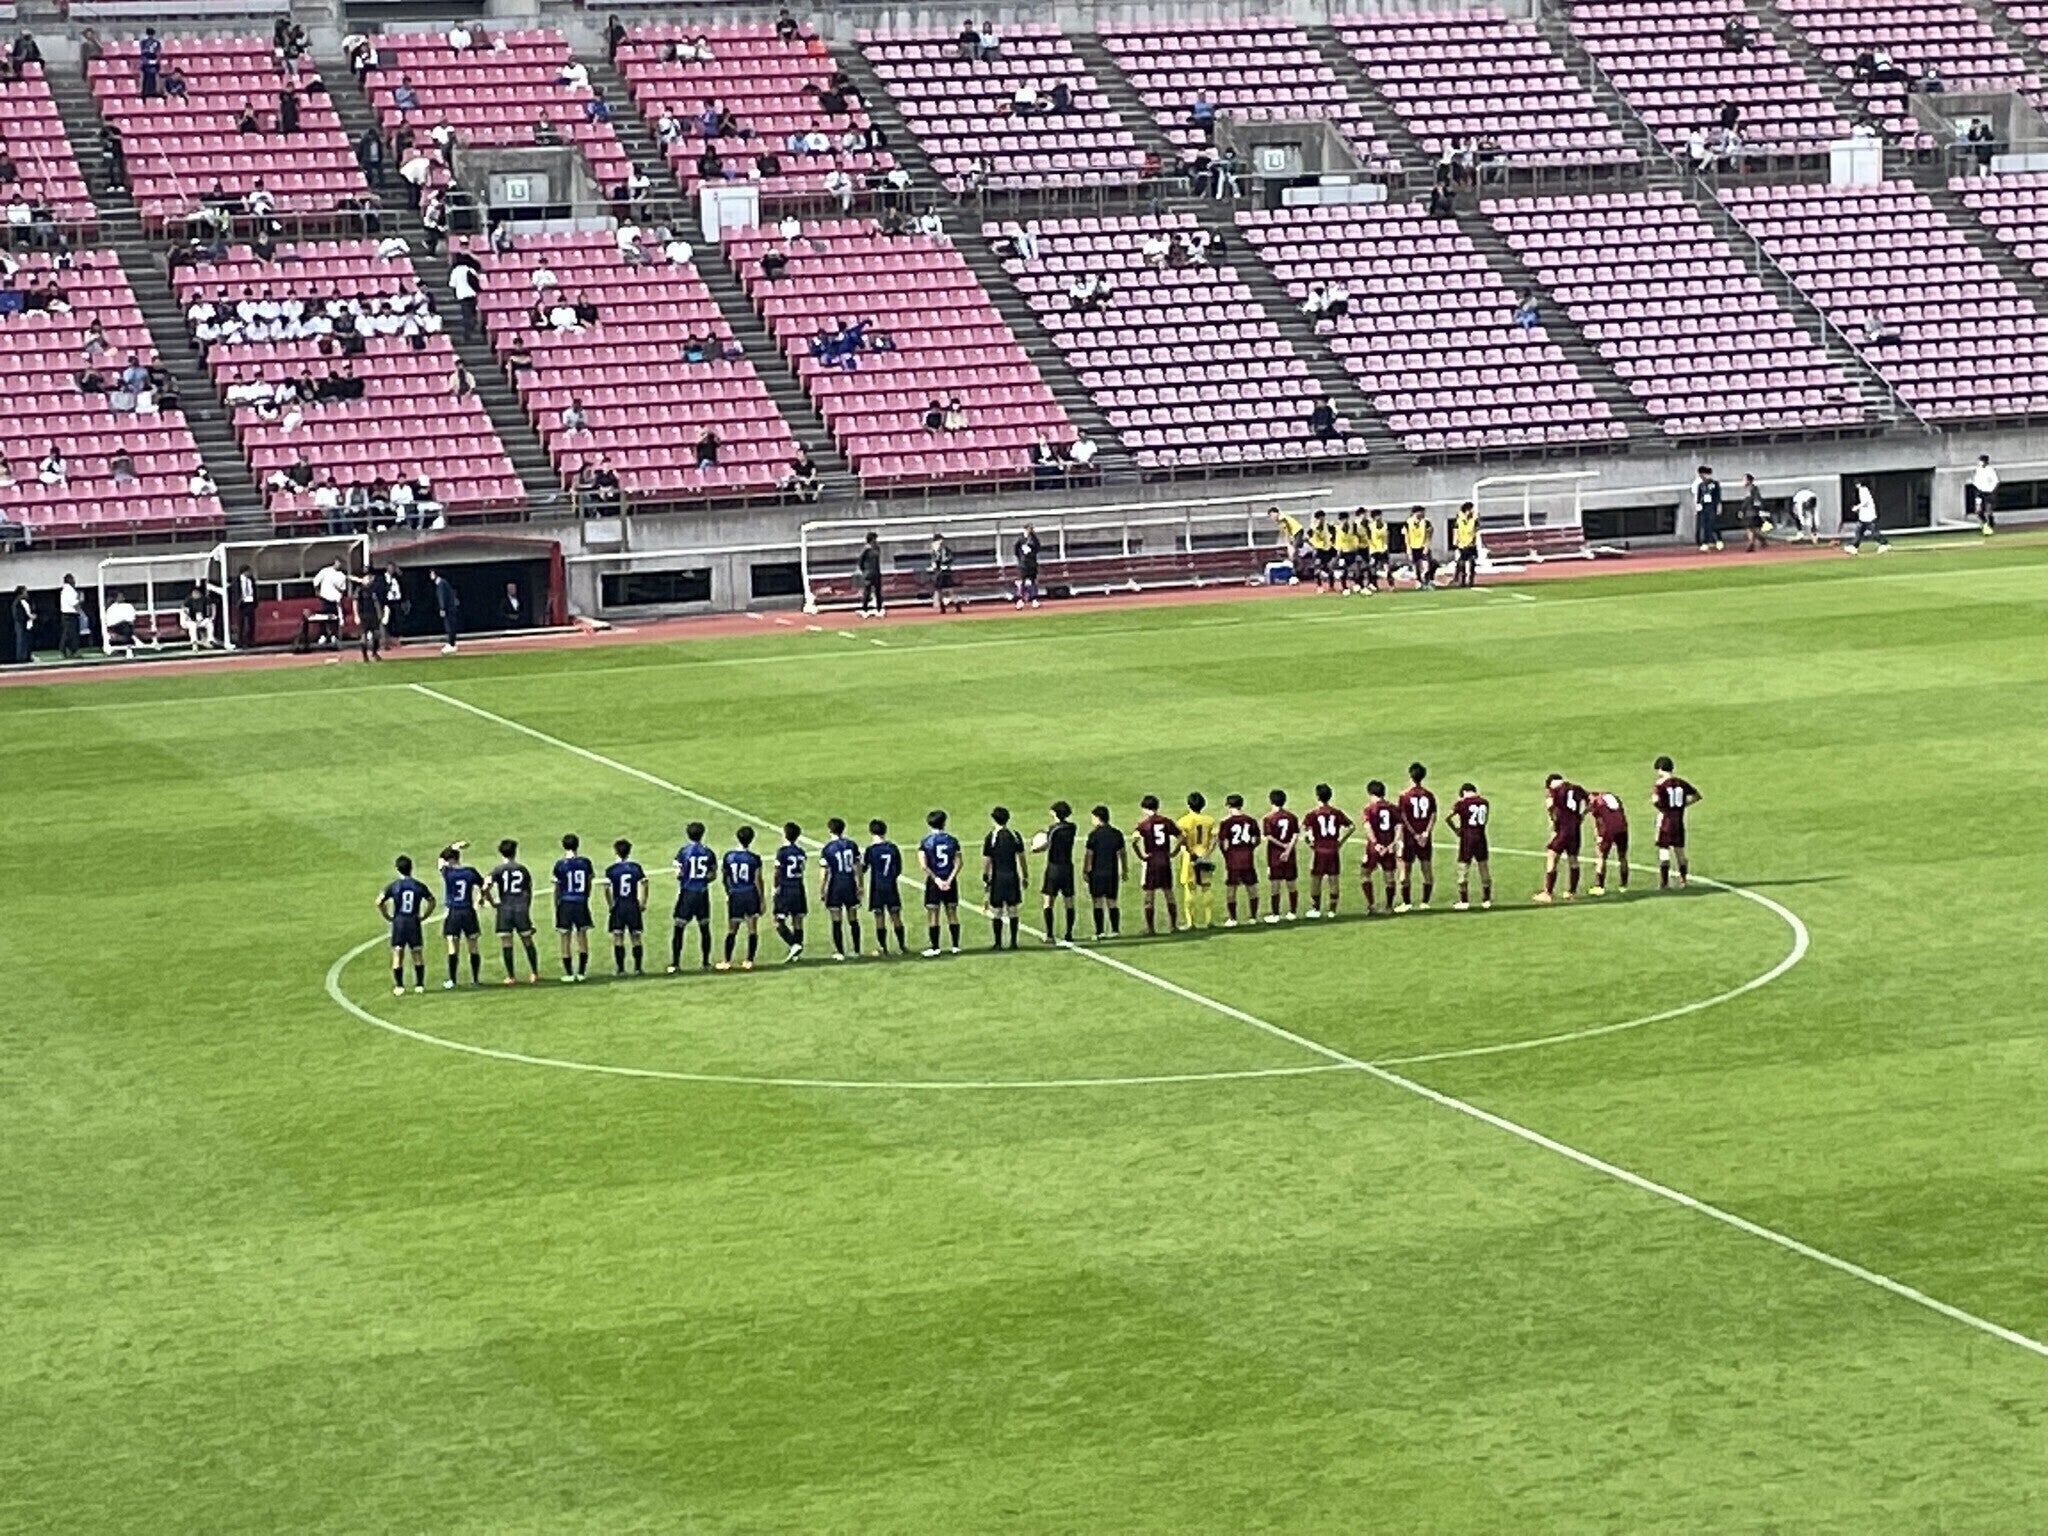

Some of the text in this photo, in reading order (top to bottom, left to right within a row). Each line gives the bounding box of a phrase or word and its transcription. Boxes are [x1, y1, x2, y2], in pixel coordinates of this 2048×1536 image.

[1410, 796, 1429, 818] 19
[1666, 786, 1684, 808] 10
[1468, 804, 1487, 826] 20
[1153, 824, 1165, 845] 5
[1196, 824, 1203, 845] 1
[1230, 823, 1250, 845] 24
[1278, 819, 1289, 839] 7
[834, 849, 854, 873] 10
[880, 854, 891, 876] 7
[936, 844, 948, 868] 5
[688, 856, 709, 879] 15
[454, 880, 466, 901] 3
[502, 870, 523, 893] 12
[567, 870, 585, 893] 19
[620, 874, 631, 897] 6
[402, 890, 414, 913] 8
